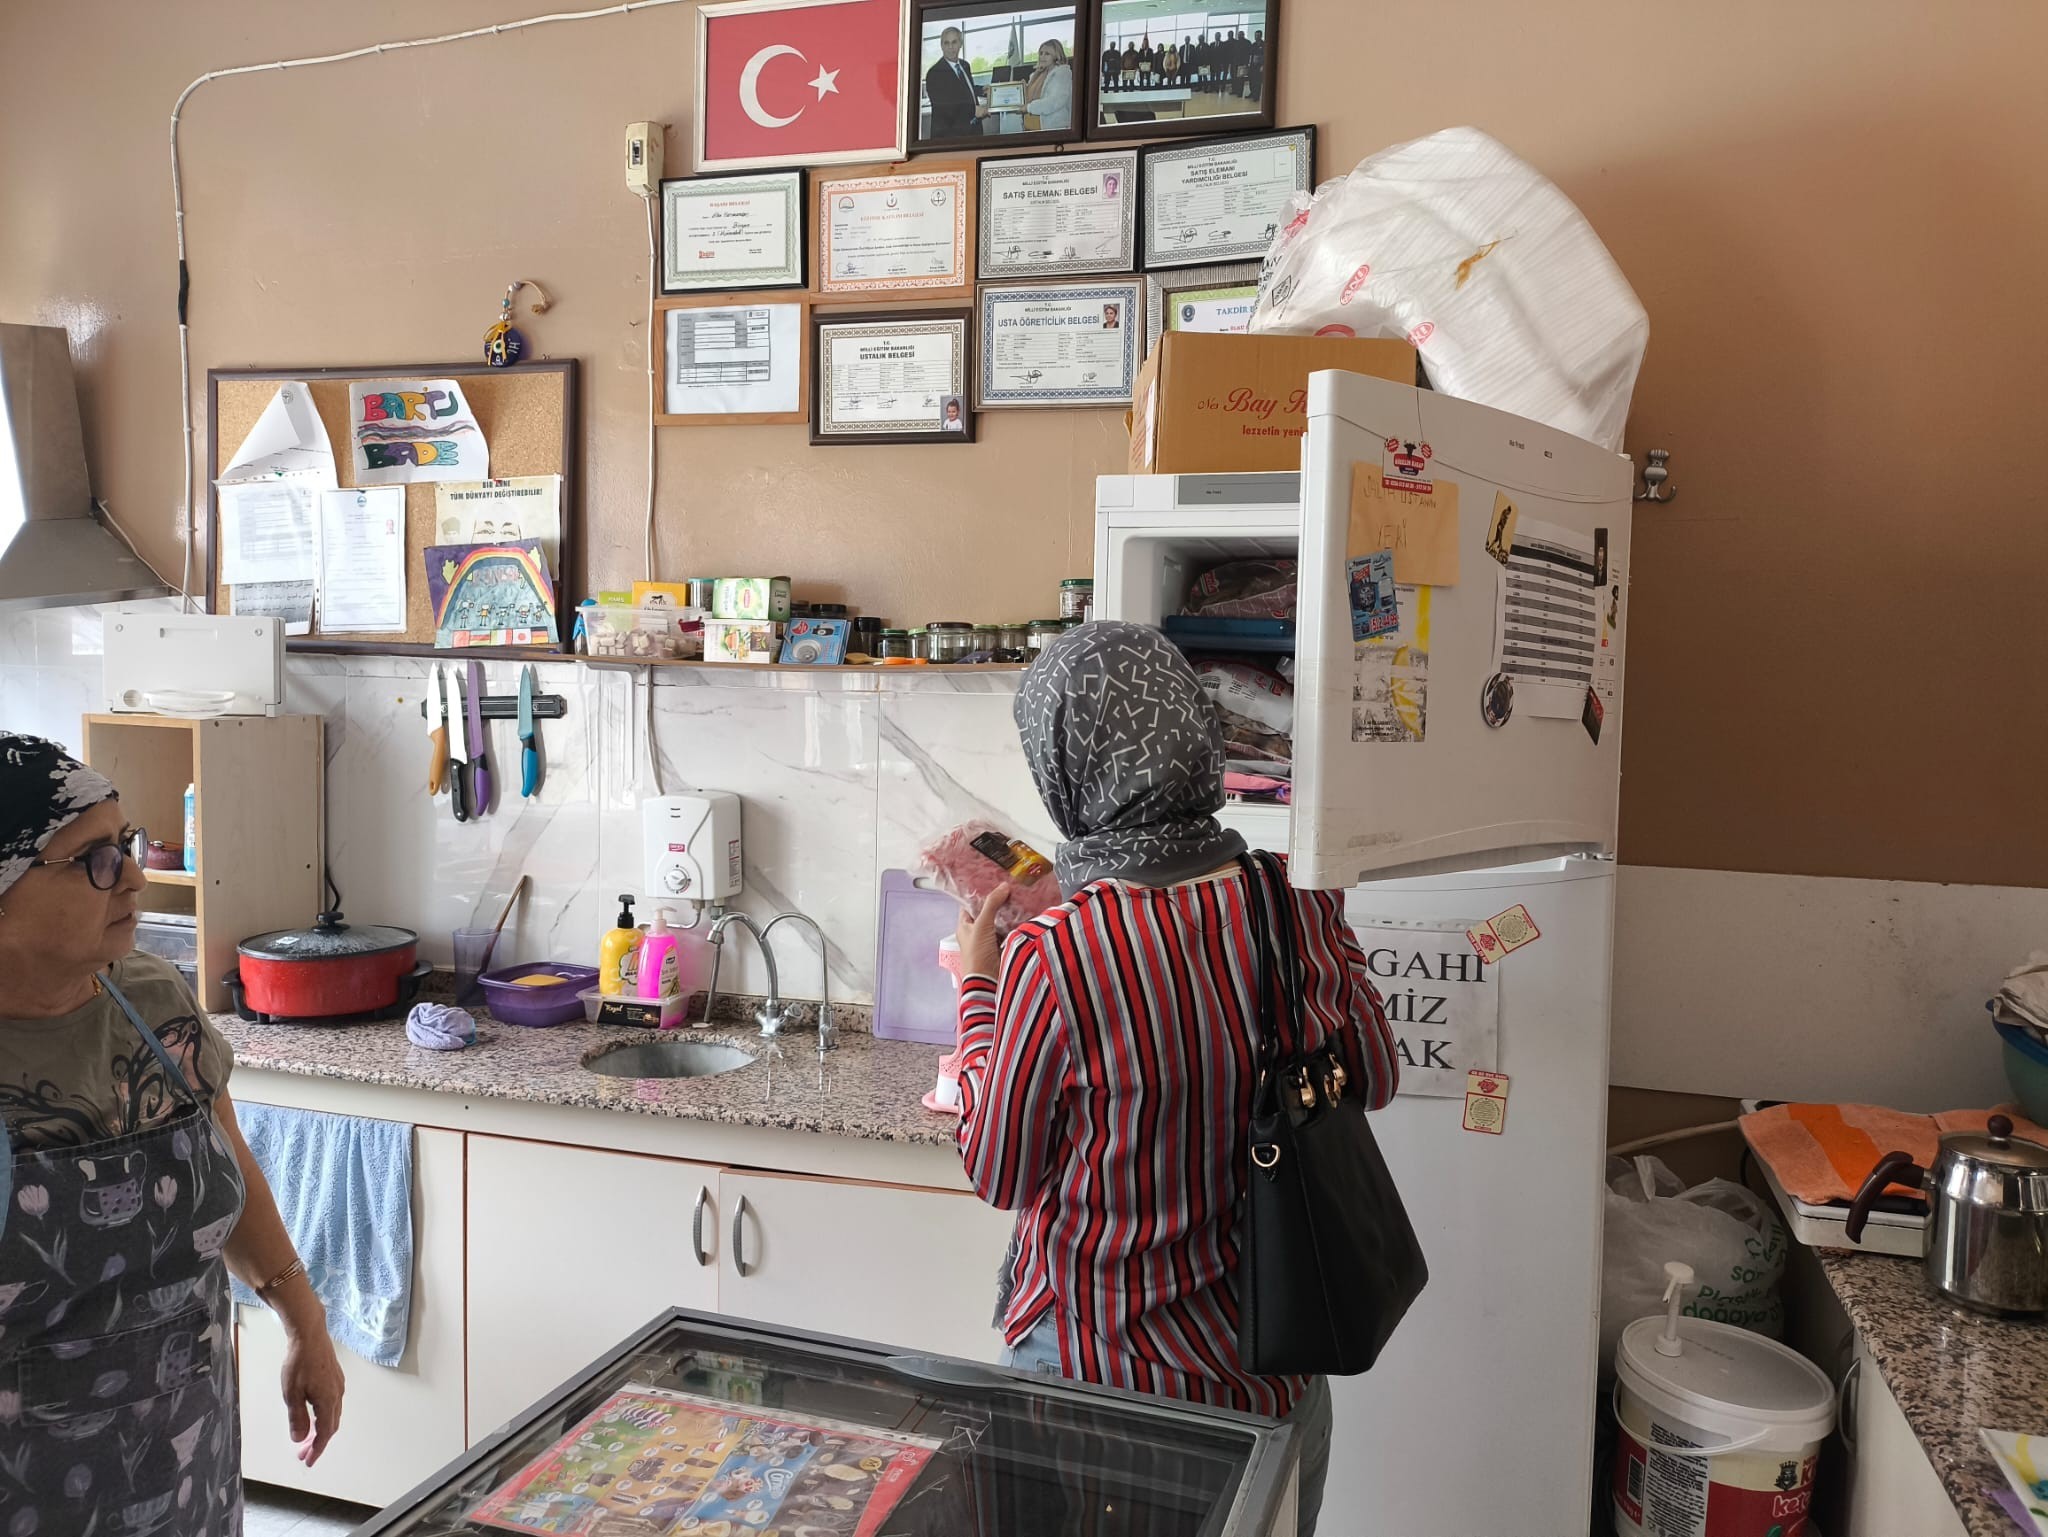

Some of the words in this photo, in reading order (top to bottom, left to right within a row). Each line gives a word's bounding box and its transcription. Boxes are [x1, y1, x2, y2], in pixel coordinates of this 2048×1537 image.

[1181, 174, 1221, 185] YARDIMCILIĞI
[1220, 171, 1248, 181] BELGESİ
[1190, 169, 1208, 177] SATIŞ
[1208, 166, 1236, 175] ELEMANI
[1003, 190, 1026, 200] SATIŞ
[1027, 189, 1062, 198] ELEMANI
[1064, 185, 1098, 196] BELGESİ
[1216, 304, 1248, 316] TAKDİR
[998, 318, 1018, 328] USTA
[1019, 314, 1066, 327] ÖĞRETİCİLİK
[1067, 314, 1100, 325] BELGESİ
[887, 351, 915, 359] BELGESİ
[1223, 387, 1278, 421] Bay
[1242, 424, 1280, 437] lezzetin
[450, 491, 464, 500] TÜM
[465, 489, 493, 500] DÜNYAYI
[1367, 948, 1487, 983] GAHI
[1397, 1037, 1456, 1070] AK
